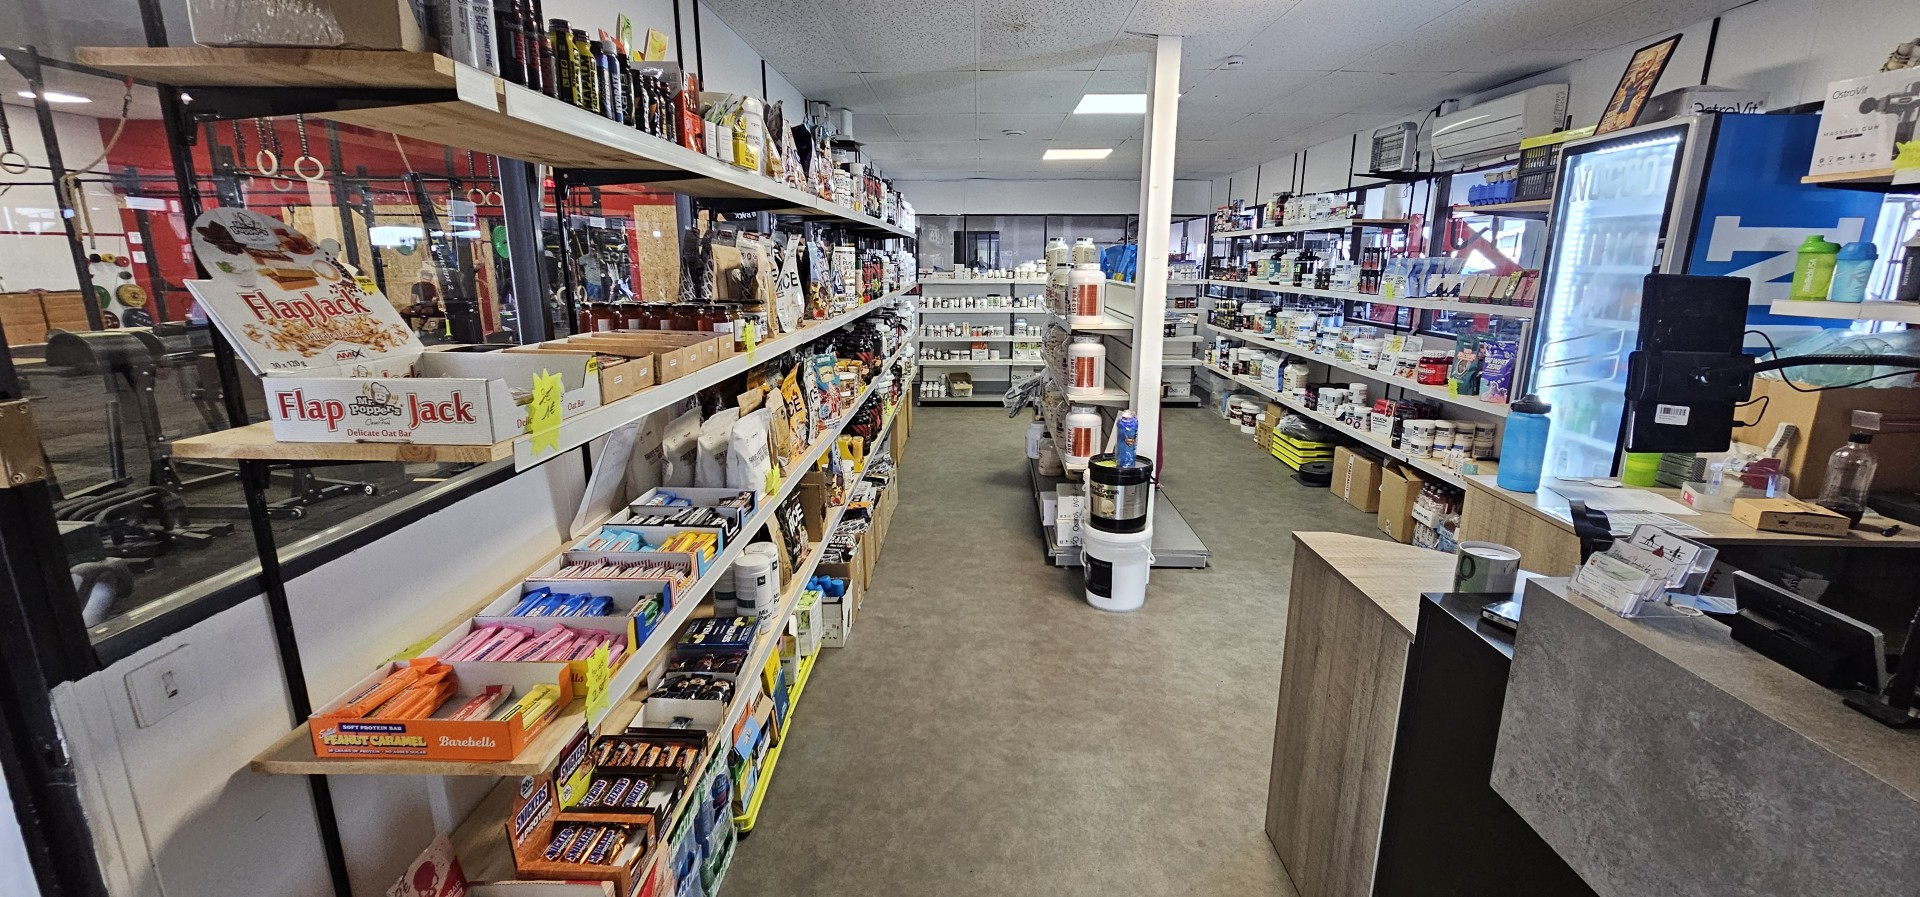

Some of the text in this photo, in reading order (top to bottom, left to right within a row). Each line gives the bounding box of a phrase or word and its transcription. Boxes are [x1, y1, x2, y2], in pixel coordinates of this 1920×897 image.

[475, 15, 483, 35] SHOT
[482, 14, 494, 68] L-CARNITINE
[612, 73, 622, 113] HYDRATE
[1832, 85, 1869, 100] OstroVit
[1823, 128, 1860, 137] MASSAGE
[237, 289, 373, 330] FlapJack
[275, 388, 346, 432] Flap
[349, 404, 402, 416] Popper's
[356, 396, 375, 406] Mr.
[406, 390, 476, 430] Jack
[347, 428, 412, 438] Delicate Oat Bar
[324, 735, 428, 747] PEANUT CARAMEL
[439, 736, 496, 747] Barebells
[561, 738, 587, 782] SNICKERS
[516, 784, 548, 833] SNICKERS
[622, 780, 648, 807] SNICKERS
[545, 828, 574, 861] SNICKERS
[565, 827, 596, 862] SNICKERS
